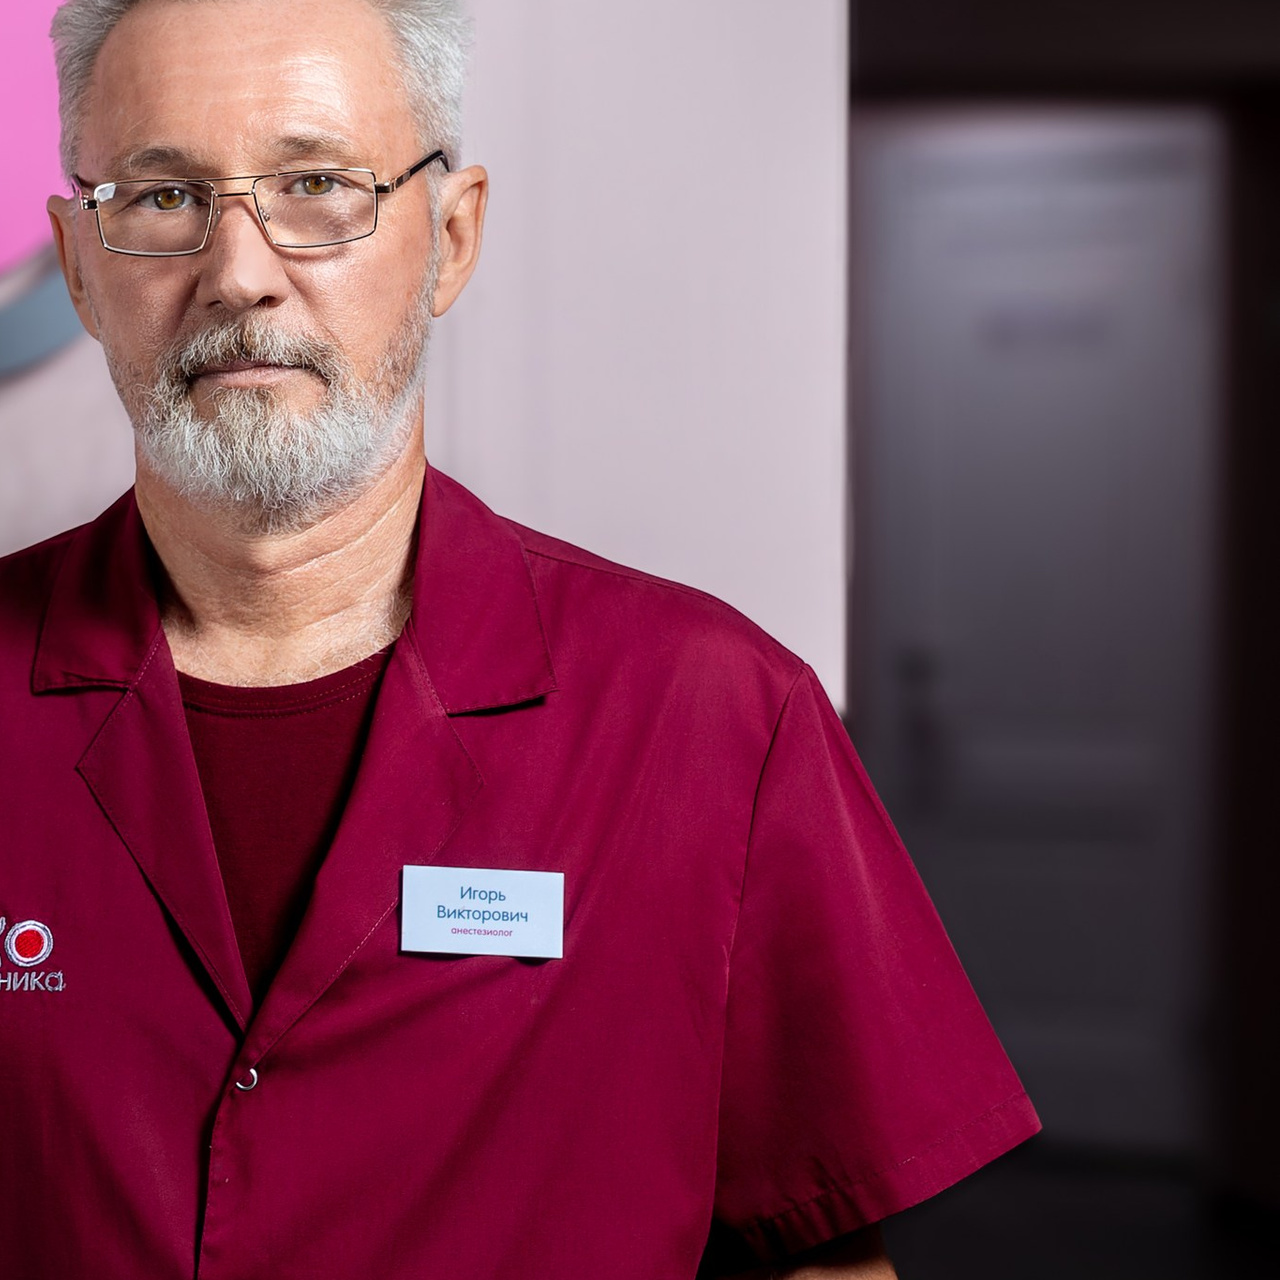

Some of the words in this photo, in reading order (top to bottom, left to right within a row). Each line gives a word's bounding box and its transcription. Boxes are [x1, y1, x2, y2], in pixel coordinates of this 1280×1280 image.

[460, 886, 506, 904] Игорь
[437, 905, 528, 923] Викторович
[451, 927, 513, 937] анестезиолог
